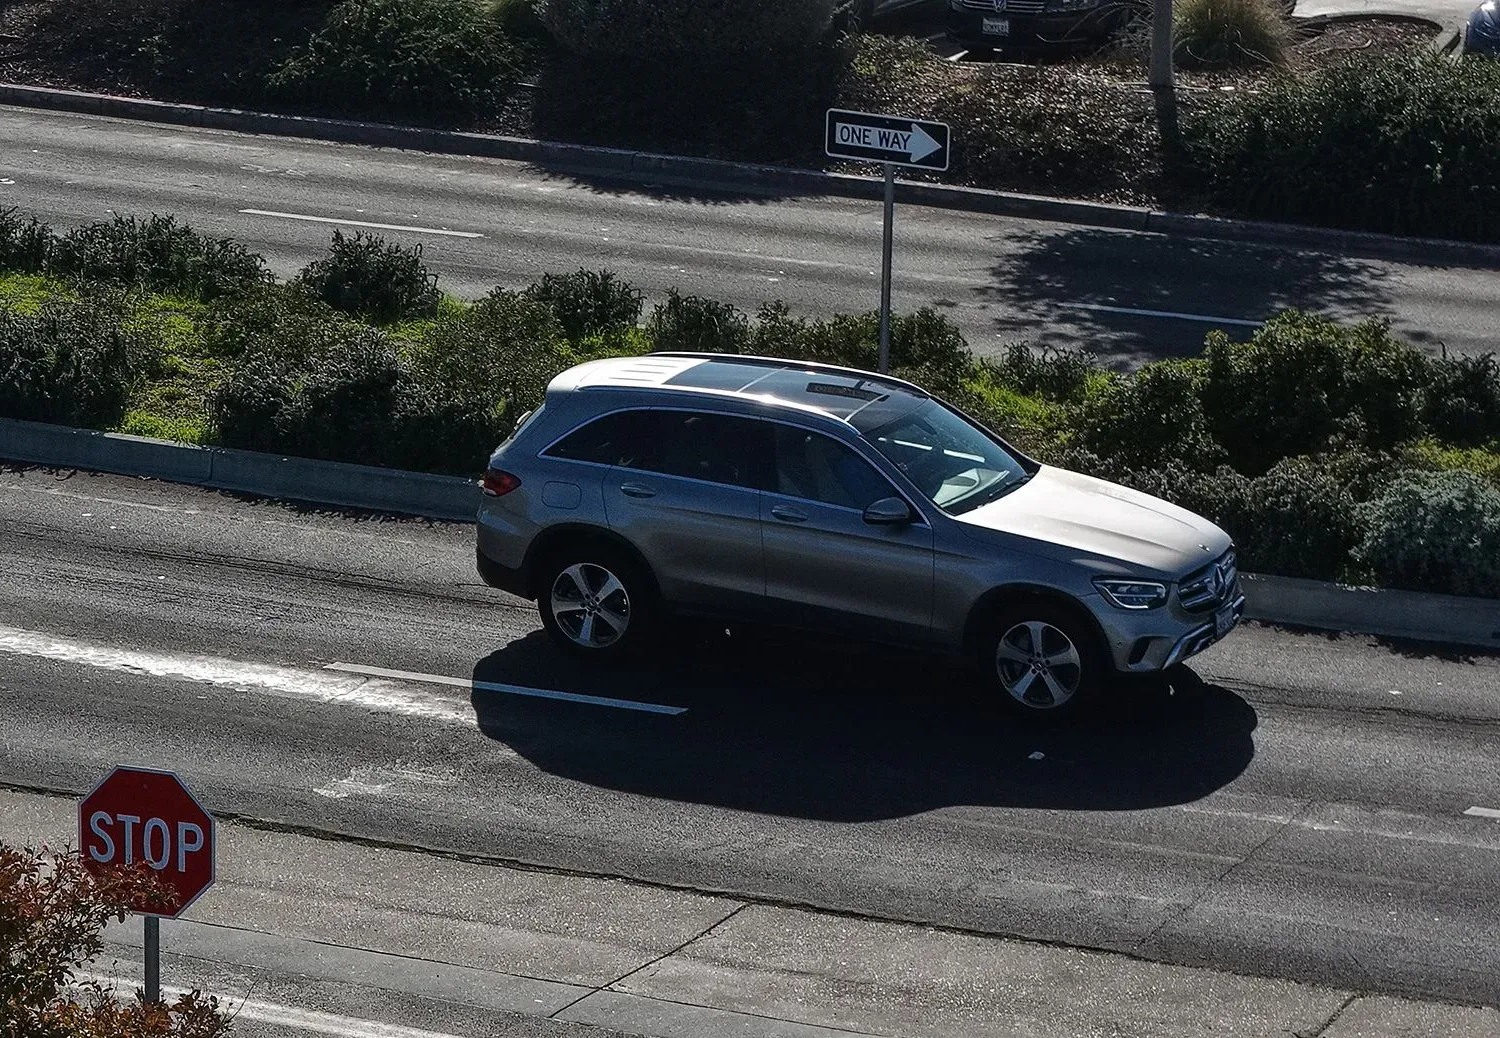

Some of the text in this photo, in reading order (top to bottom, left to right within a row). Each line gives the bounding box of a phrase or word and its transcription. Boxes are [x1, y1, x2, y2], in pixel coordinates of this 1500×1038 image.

[840, 125, 911, 150] ONE WAY
[89, 811, 204, 872] STOP
